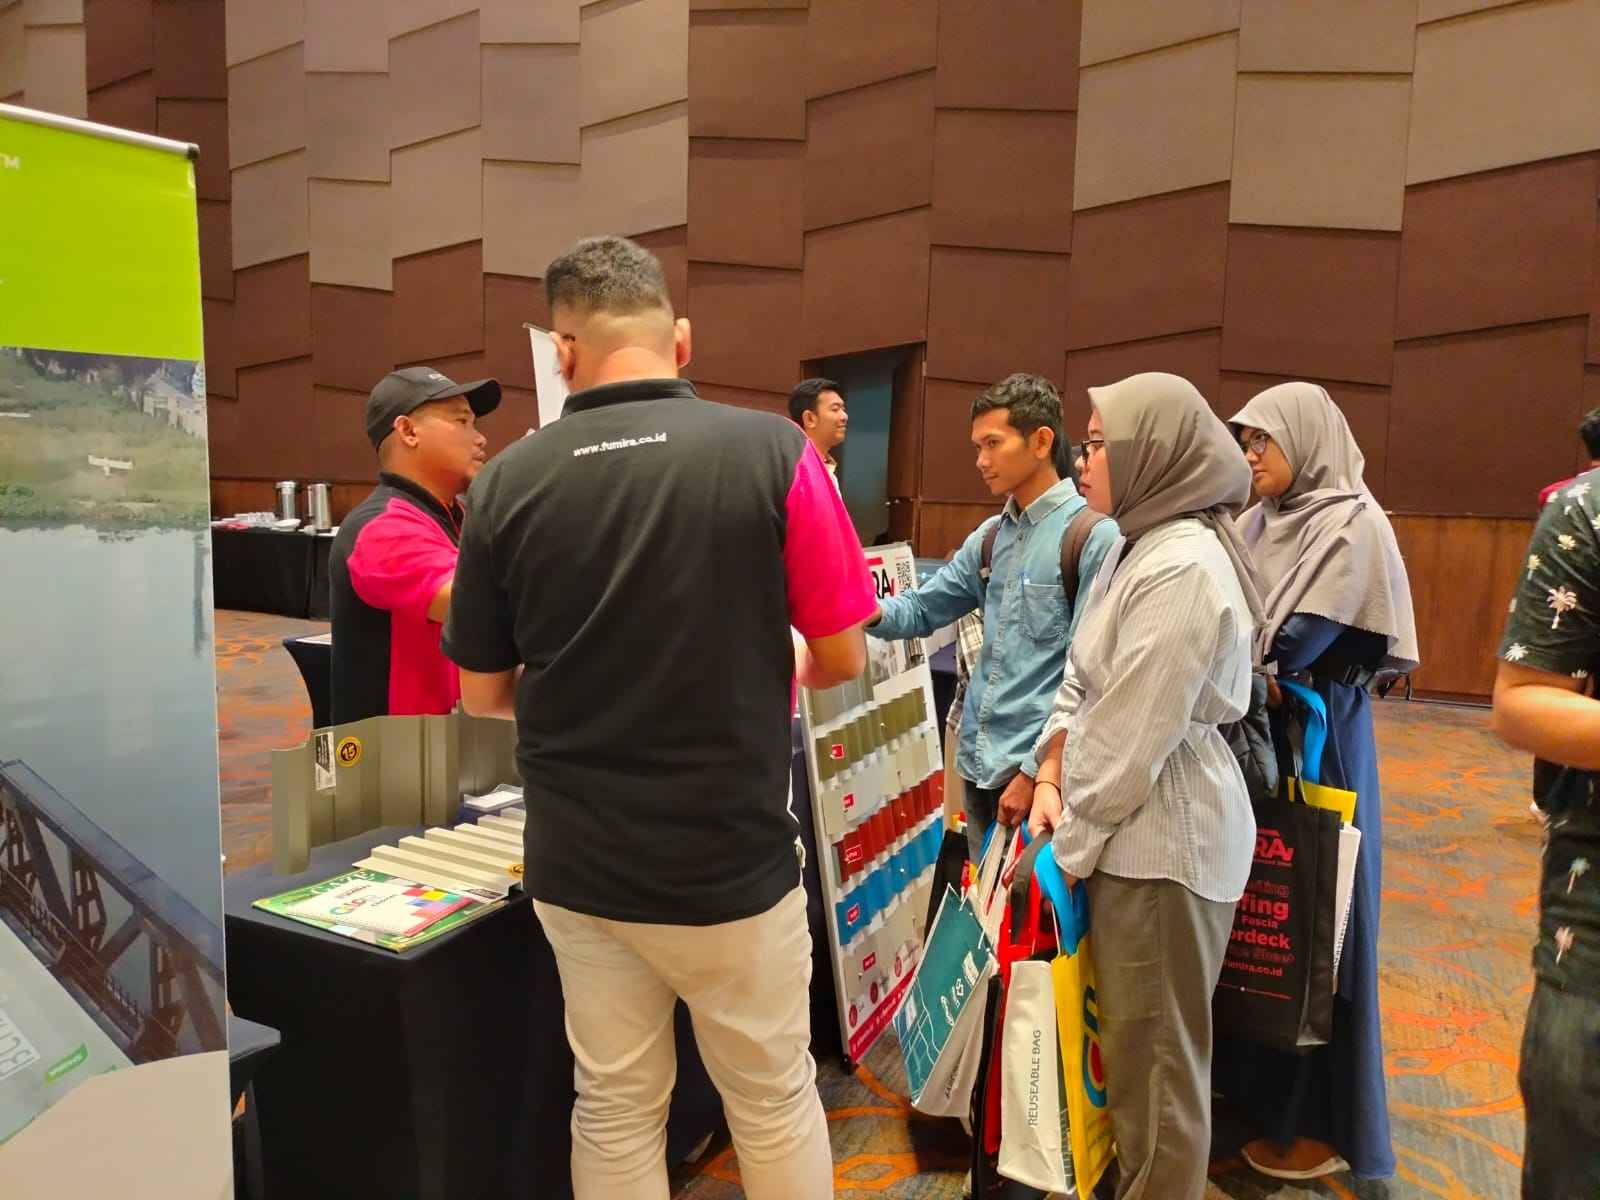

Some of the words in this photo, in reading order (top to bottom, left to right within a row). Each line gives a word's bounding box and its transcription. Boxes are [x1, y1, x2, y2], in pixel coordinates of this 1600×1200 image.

[573, 432, 667, 457] www.fumira.co.id
[1237, 893, 1289, 921] fing
[1032, 1029, 1042, 1056] BAG
[1028, 1057, 1041, 1127] REUSEABLE
